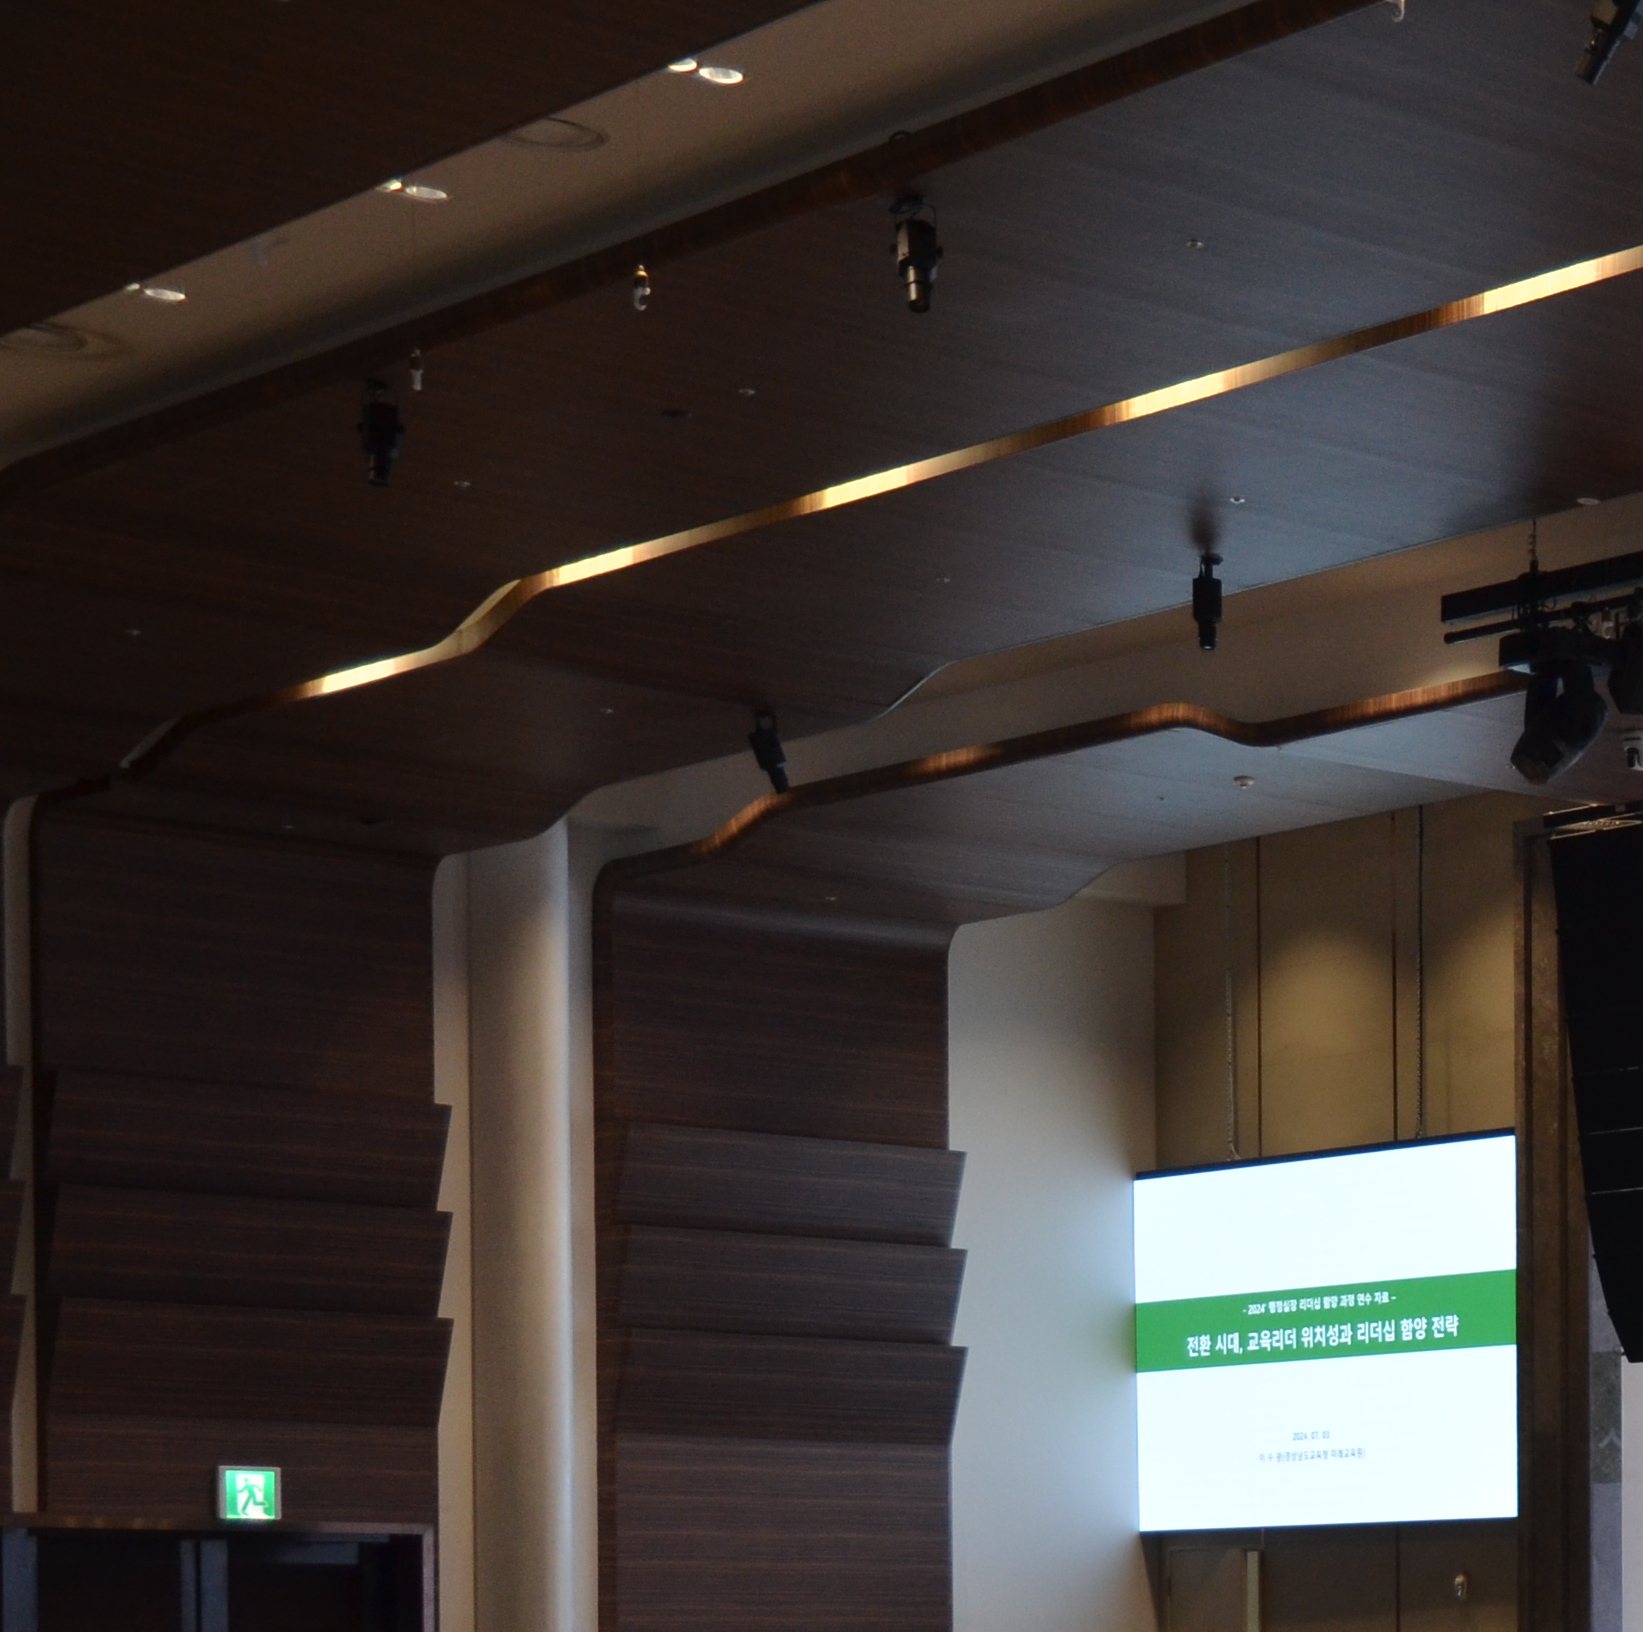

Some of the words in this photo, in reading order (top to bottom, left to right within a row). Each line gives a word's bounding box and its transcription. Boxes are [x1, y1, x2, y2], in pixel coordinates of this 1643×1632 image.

[1186, 1335, 1211, 1357] 전환
[1215, 1332, 1243, 1355] 시대,
[1247, 1328, 1297, 1352] 교육리더
[1301, 1323, 1353, 1348] 위치성과
[1357, 1320, 1395, 1344] 리더십
[1400, 1316, 1427, 1341] 함양
[1431, 1314, 1459, 1338] 전략
